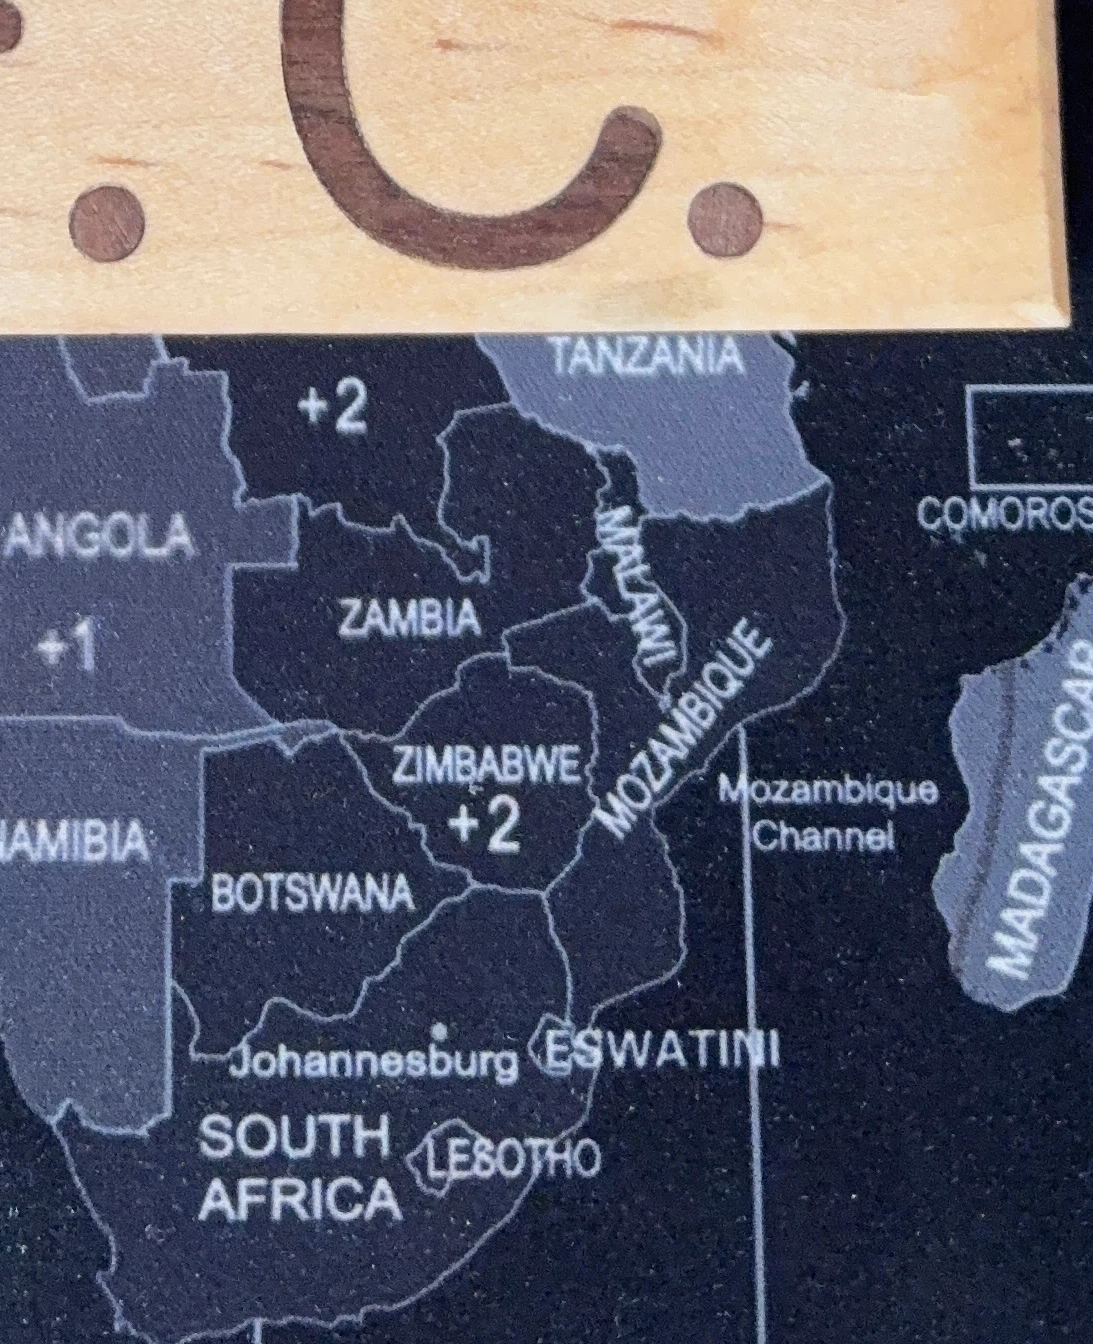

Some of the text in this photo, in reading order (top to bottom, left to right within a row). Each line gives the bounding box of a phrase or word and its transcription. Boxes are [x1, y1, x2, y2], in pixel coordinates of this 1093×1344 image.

[548, 335, 744, 376] TANZANIA
[298, 376, 369, 435] +2
[4, 512, 197, 558] ANGOLA
[595, 504, 677, 668] MALAWI
[339, 597, 481, 639] ZAMBIA
[36, 614, 96, 671] +1
[594, 615, 773, 841] MOZAMBIQUE
[392, 745, 582, 785] ZIMBABWE
[718, 772, 940, 812] Mozambique
[448, 795, 521, 854] +2
[753, 819, 896, 853] Channel
[211, 873, 415, 912] BOTSWANA
[229, 1044, 519, 1087] Johannesburg
[545, 1030, 780, 1069] ESWATINI
[200, 1113, 390, 1160] SOUTH
[425, 1137, 602, 1179] LESOTHO
[199, 1176, 404, 1222] AFRICA
